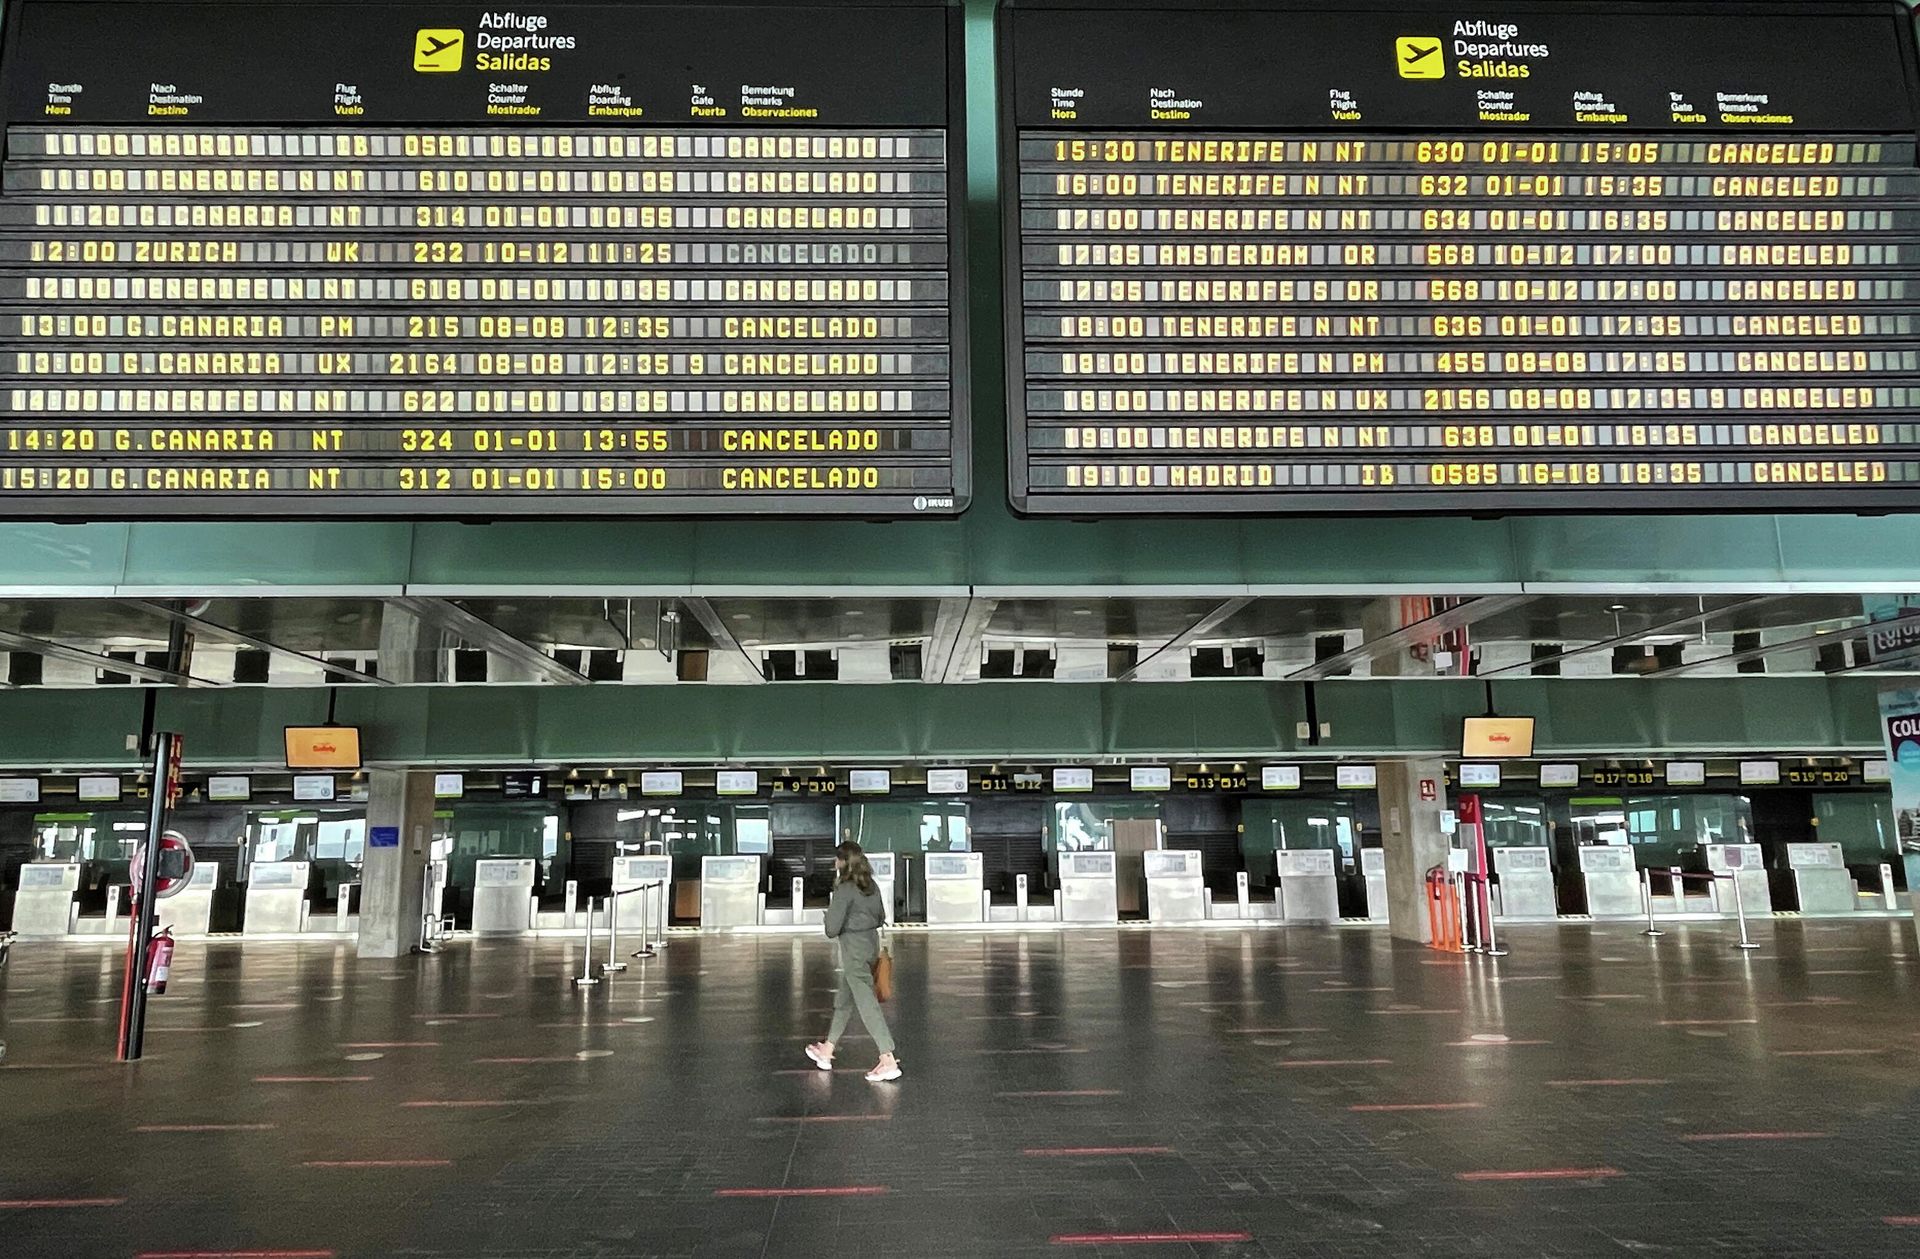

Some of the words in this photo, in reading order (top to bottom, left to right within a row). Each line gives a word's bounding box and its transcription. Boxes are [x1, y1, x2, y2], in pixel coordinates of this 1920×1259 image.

[479, 12, 547, 32] Abfluge
[1453, 20, 1518, 40] Abfluge
[477, 33, 576, 51] Departures
[1454, 40, 1549, 59] Departures
[475, 53, 551, 71] Salidas
[1458, 60, 1530, 78] Salidas
[49, 83, 83, 92] Stunde
[151, 83, 176, 93] Nach
[336, 84, 356, 94] Flug
[692, 85, 706, 94] Tor
[1050, 88, 1084, 98] Stunde
[1150, 88, 1175, 98] Nach
[1329, 89, 1350, 100] Flug
[1670, 92, 1683, 101] Tor
[48, 94, 72, 103] Time
[150, 94, 202, 104] Destination
[335, 94, 361, 104] Flight
[488, 94, 525, 103] Counter
[589, 95, 631, 105] Boarding
[741, 96, 783, 106] Remarks
[1052, 99, 1075, 108] Time
[1151, 99, 1202, 109] Destination
[1331, 100, 1357, 110] Flight
[1478, 101, 1514, 110] Counter
[1575, 101, 1615, 112] Boarding
[1718, 103, 1758, 112] Remarks
[45, 105, 71, 114] Hora
[148, 105, 188, 115] Destino
[335, 105, 364, 115] Vuelo
[487, 105, 541, 115] Mostrador
[588, 106, 643, 117] Embarque
[691, 107, 726, 116] Puerta
[741, 107, 818, 117] Observaciones
[1052, 109, 1076, 119] Hora
[1151, 109, 1190, 119] Destino
[1332, 111, 1361, 120] Vuelo
[1479, 111, 1530, 121] Mostrador
[1576, 112, 1628, 123] Embarque
[1673, 114, 1706, 123] Puerta
[1721, 114, 1793, 124] Observaciones
[1056, 141, 1135, 161] 15:30
[1155, 141, 1284, 161] TENERIFE
[1303, 142, 1317, 162] N
[1336, 142, 1365, 162] NT
[1418, 142, 1465, 162] 630
[1483, 142, 1560, 162] 01-01
[1581, 143, 1658, 163] 15:05
[1708, 144, 1833, 163] CANCELED
[1057, 175, 1136, 195] 16:00
[1157, 175, 1286, 195] TENERIFE
[1306, 176, 1319, 195] N
[1339, 176, 1368, 195] NT
[1421, 176, 1467, 195] 632
[1487, 176, 1564, 195] 01-01
[1585, 176, 1662, 196] 15:35
[1713, 177, 1838, 196] CANCELED
[1060, 210, 1138, 229] 17:00
[1159, 210, 1287, 230] TENERIFE
[1308, 211, 1322, 229] N
[1341, 210, 1371, 229] NT
[1422, 210, 1470, 230] 634
[1490, 210, 1566, 230] 01-01
[1591, 211, 1666, 230] 16:35
[1718, 211, 1844, 230] CANCELED
[32, 241, 115, 261] 12:00
[135, 242, 237, 262] ZURICH
[327, 242, 358, 262] WK
[414, 243, 463, 262] 232
[484, 243, 567, 263] 10-12
[588, 243, 671, 263] 11:25
[727, 244, 876, 263] CANCELADO
[1160, 245, 1308, 265] AMSTERDAM
[1723, 245, 1850, 265] CANCELED
[1062, 281, 1141, 301] 17:35
[1163, 281, 1293, 301] TENERIFE
[1314, 281, 1327, 300] S
[1348, 281, 1378, 300] OR
[1431, 281, 1478, 300] 568
[1498, 281, 1577, 300] 10-12
[1599, 282, 1676, 300] 17:00
[1728, 281, 1855, 300] CANCELED
[22, 316, 106, 336] 13:00
[127, 316, 282, 336] G.CANARIA
[321, 316, 352, 336] PM
[409, 317, 458, 337] 215
[480, 317, 564, 337] 08-08
[585, 317, 669, 337] 12:35
[725, 318, 877, 337] CANCELADO
[1062, 317, 1143, 336] 18:00
[1163, 317, 1295, 336] TENERIFE
[1316, 317, 1329, 336] N
[1350, 317, 1379, 336] NT
[1435, 316, 1481, 336] 636
[1502, 316, 1579, 335] 01-01
[1604, 316, 1680, 335] 17:35
[1733, 316, 1861, 335] CANCELED
[18, 353, 102, 373] 13:00
[124, 353, 280, 373] G.CANARIA
[319, 354, 351, 374] UX
[390, 354, 457, 374] 2164
[476, 354, 563, 374] 08-08
[585, 354, 668, 374] 12:35
[690, 354, 703, 374] 9
[725, 354, 877, 374] CANCELADO
[9, 430, 94, 450] 14:20
[116, 430, 273, 450] G.CANARIA
[313, 430, 345, 450] NT
[403, 430, 452, 450] 324
[475, 430, 559, 450] 01-01
[583, 430, 667, 450] 13:55
[723, 430, 877, 450] CANCELADO
[3, 468, 89, 489] 15:20
[111, 469, 271, 489] G.CANARIA
[309, 468, 340, 489] NT
[400, 469, 452, 489] 312
[472, 469, 557, 489] 01-01
[580, 469, 668, 489] 15:00
[723, 468, 878, 488] CANCELADO
[1067, 466, 1150, 486] 19:10
[1171, 465, 1272, 486] MADRID
[1362, 465, 1394, 485] IB
[1432, 464, 1497, 484] 0585
[1518, 464, 1600, 484] 16-18
[1621, 463, 1701, 483] 18:35
[1754, 462, 1885, 482] CANCELED
[1892, 718, 1920, 737] COL
[1607, 773, 1619, 784] 17
[1638, 773, 1653, 784] 18
[1802, 772, 1815, 782] 19
[1834, 772, 1848, 782] 20
[792, 781, 800, 792] 9
[821, 781, 835, 792] 10
[994, 780, 1007, 790] 11
[1201, 778, 1214, 789] 13
[1233, 777, 1246, 788] 14
[584, 785, 591, 794] 7
